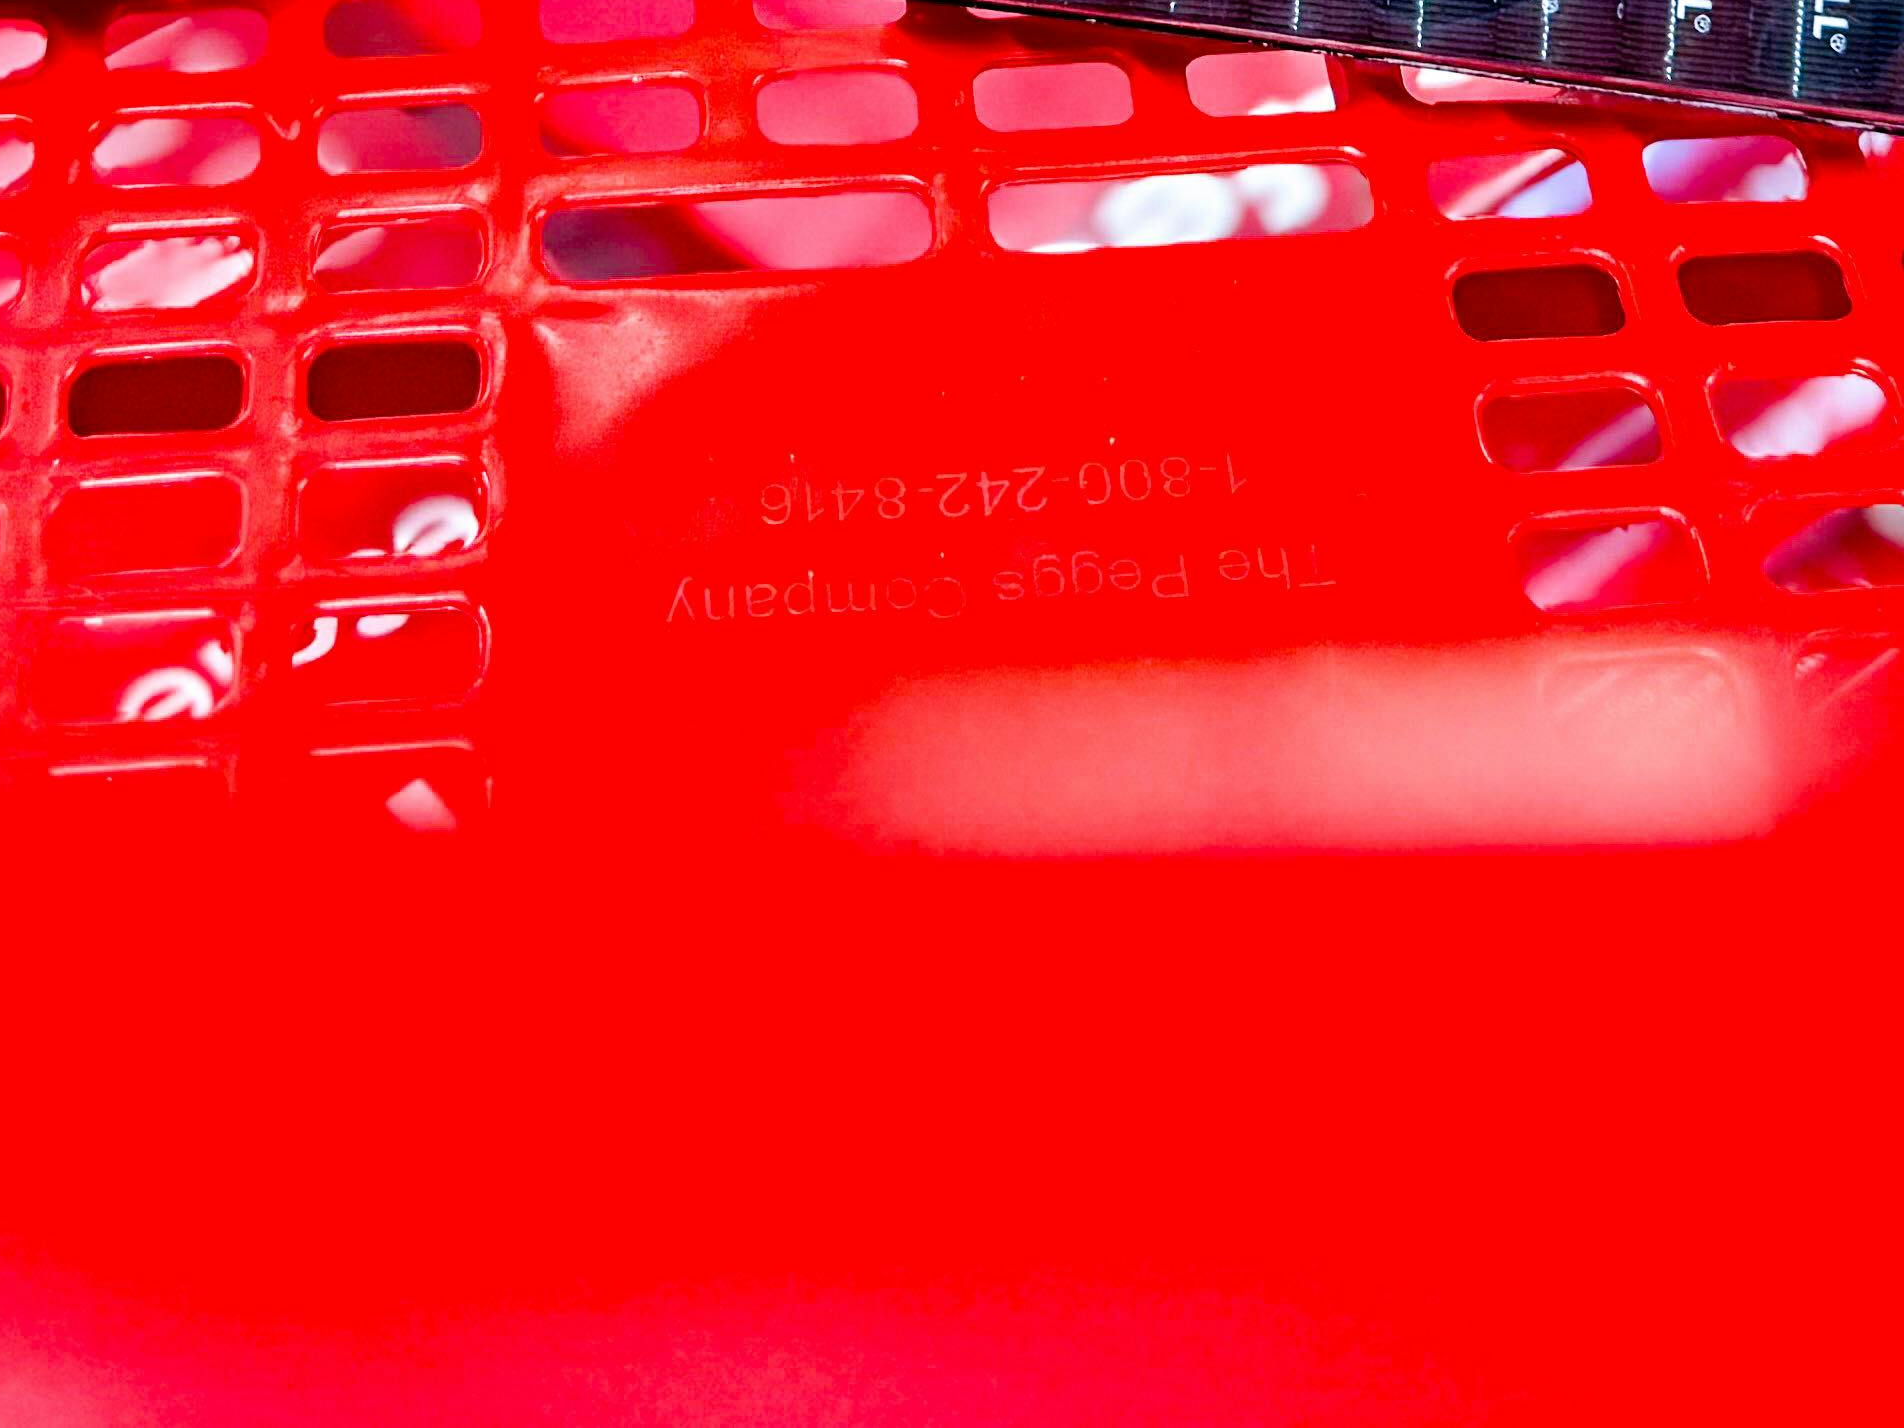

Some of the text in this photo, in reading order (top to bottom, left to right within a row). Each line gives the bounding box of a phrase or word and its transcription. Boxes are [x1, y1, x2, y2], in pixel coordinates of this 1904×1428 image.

[760, 453, 1248, 524] 1-800-242-8416
[664, 545, 1337, 622] The Peggs Company
